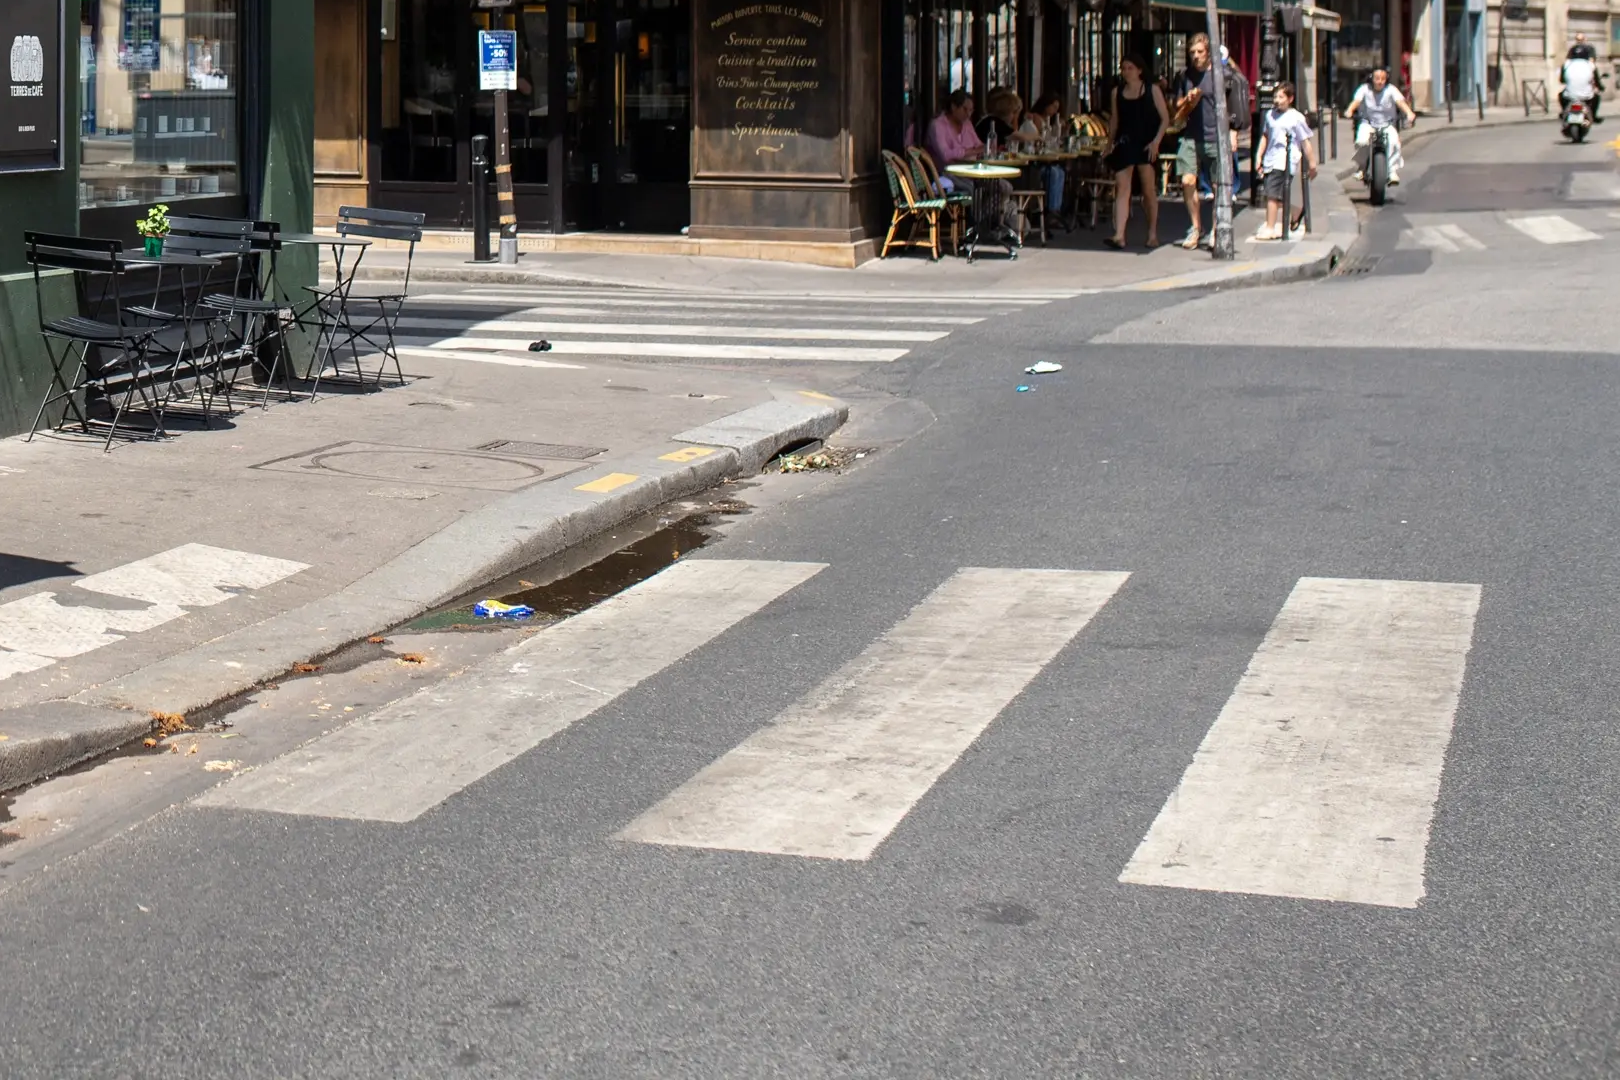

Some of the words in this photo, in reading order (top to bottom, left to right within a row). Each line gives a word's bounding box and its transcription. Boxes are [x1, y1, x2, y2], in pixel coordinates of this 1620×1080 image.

[784, 6, 797, 16] LES
[798, 11, 823, 27] JOURS
[725, 32, 762, 46] Service
[766, 34, 808, 46] continu
[490, 49, 509, 58] -50%
[718, 54, 756, 67] Cuisine
[766, 55, 818, 67] tradition
[716, 76, 739, 88] Vins
[763, 77, 819, 93] Champagnes
[735, 96, 796, 110] Cocktails
[731, 121, 802, 142] Spiritueux
